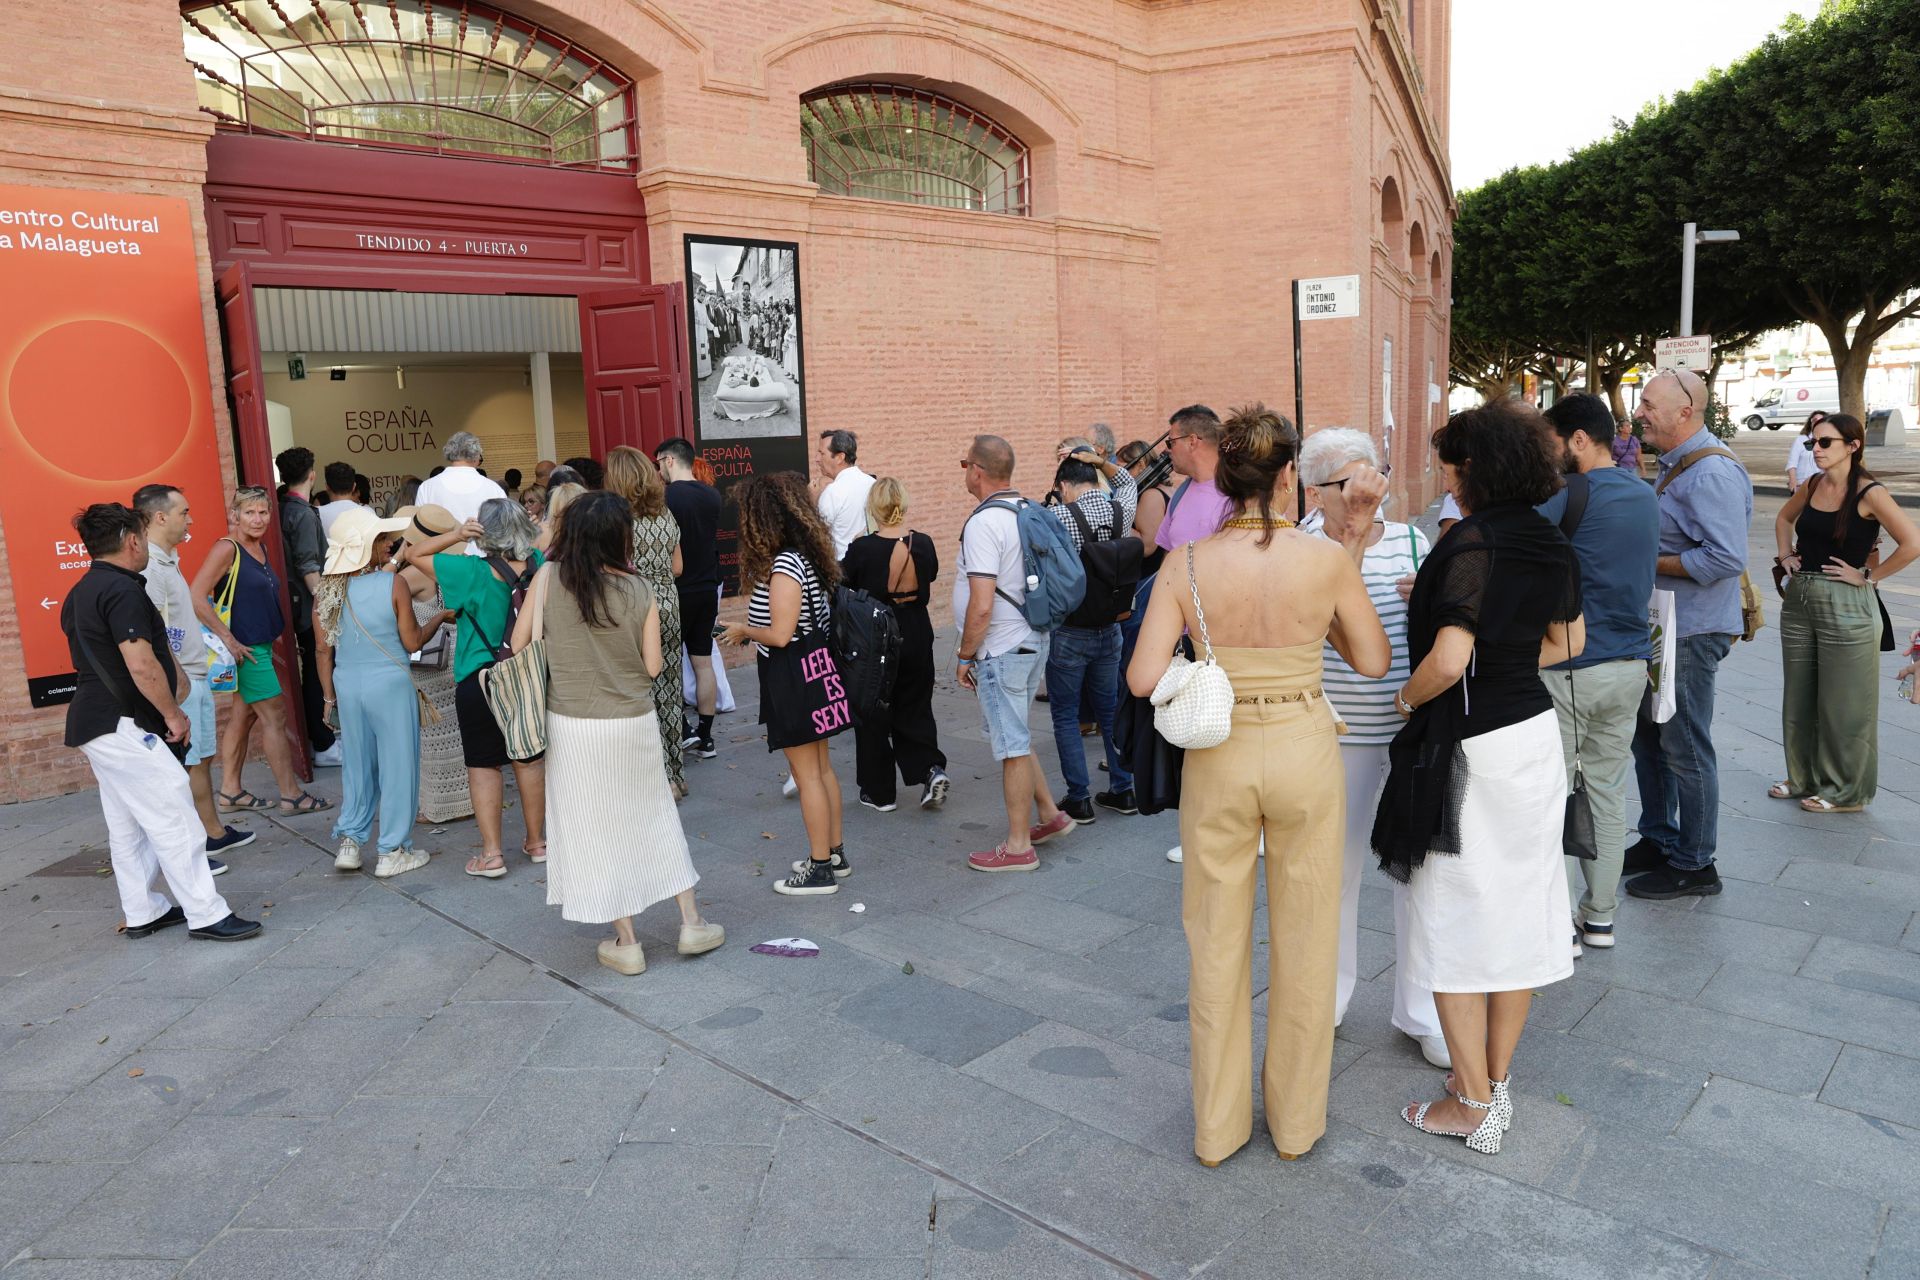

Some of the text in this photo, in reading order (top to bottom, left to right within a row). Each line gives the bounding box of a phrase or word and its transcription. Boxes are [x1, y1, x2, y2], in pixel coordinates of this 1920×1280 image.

[71, 211, 160, 233] Cultural
[20, 231, 142, 257] Malagueta
[356, 234, 431, 252] TENDIDO
[439, 240, 448, 252] 4
[465, 241, 516, 255] PUERTA
[520, 243, 528, 255] 9
[1306, 292, 1335, 303] ANTONIO
[345, 405, 434, 431] ESPAÑA
[347, 431, 437, 453] OCULTA
[702, 444, 752, 462] ESPAÑA
[368, 475, 401, 489] ISTIN
[800, 647, 837, 684] LEER
[823, 673, 846, 702] ES
[811, 699, 851, 735] SEXY
